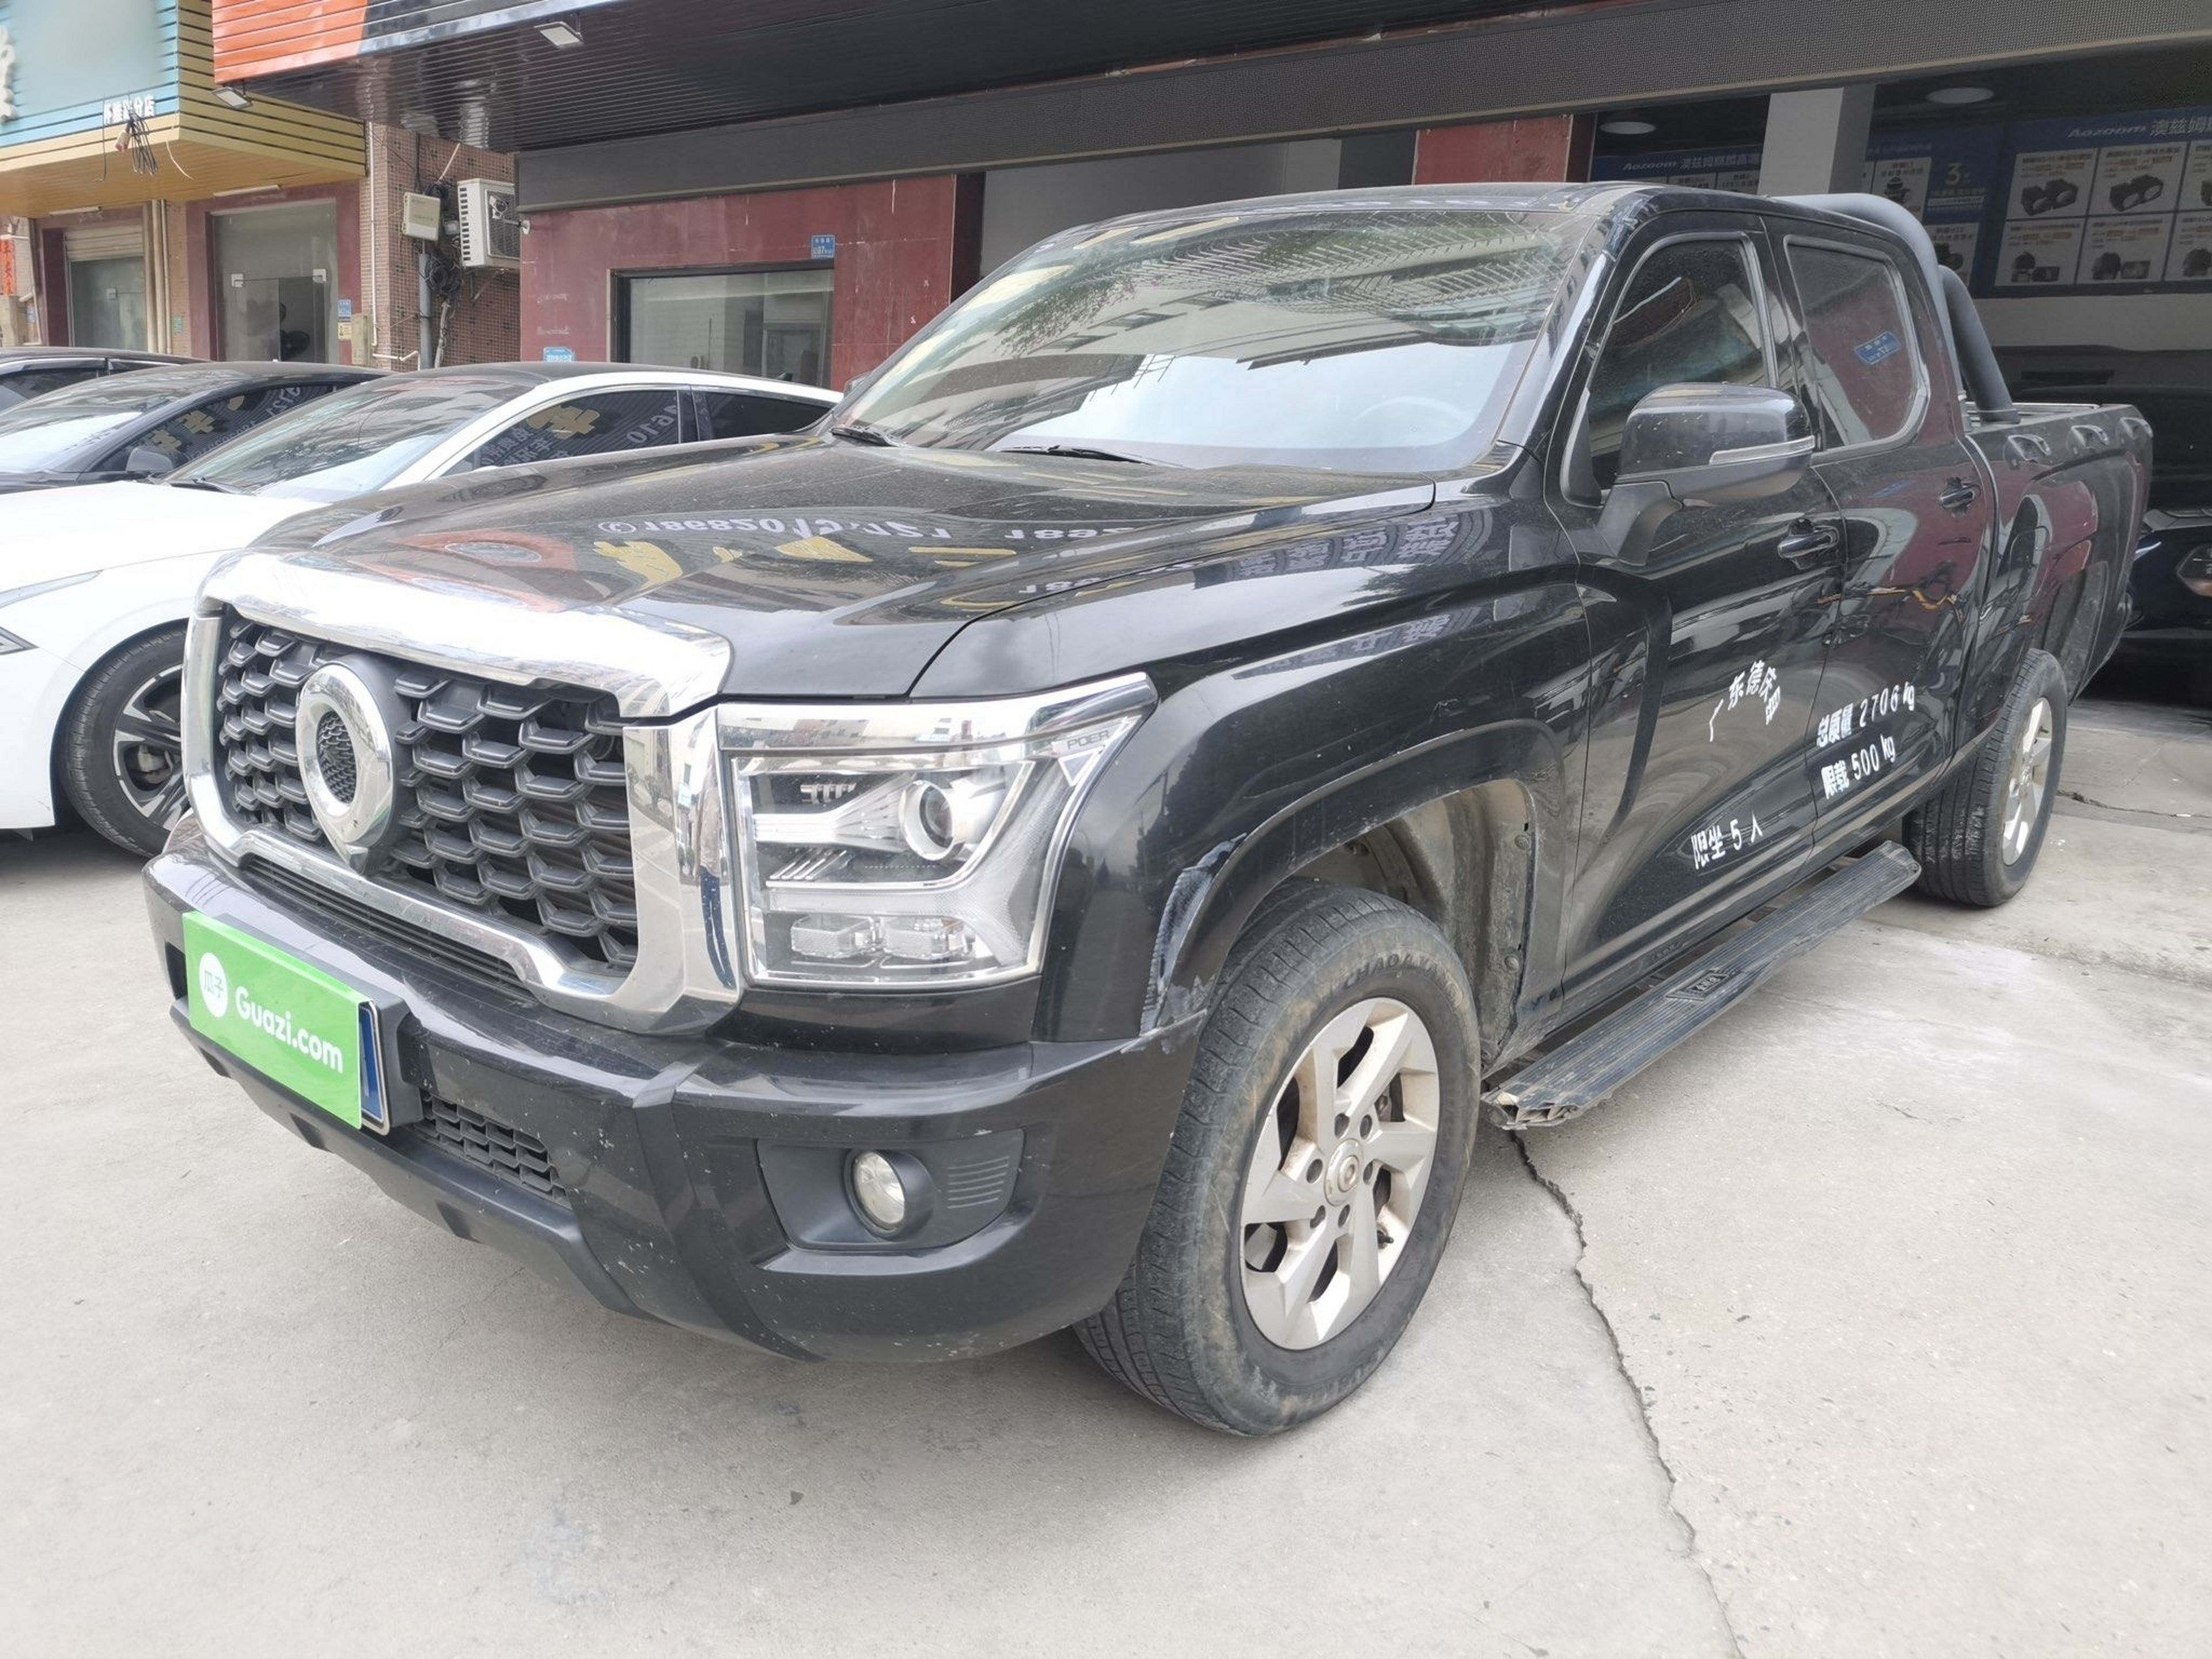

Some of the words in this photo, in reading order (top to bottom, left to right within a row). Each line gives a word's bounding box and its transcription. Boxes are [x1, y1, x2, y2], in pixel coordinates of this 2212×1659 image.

[1816, 702, 1854, 748] 总质量
[1859, 684, 1900, 727] 2706
[1902, 681, 1916, 711] kg
[1821, 759, 1851, 800] 限载
[1851, 744, 1880, 781] 500
[1881, 734, 1896, 763] kg
[1691, 825, 1726, 870] 限坐
[1730, 819, 1743, 850] 5
[1751, 812, 1762, 843] 人
[204, 970, 224, 999] 瓜子
[235, 986, 343, 1073] Guazi.com
